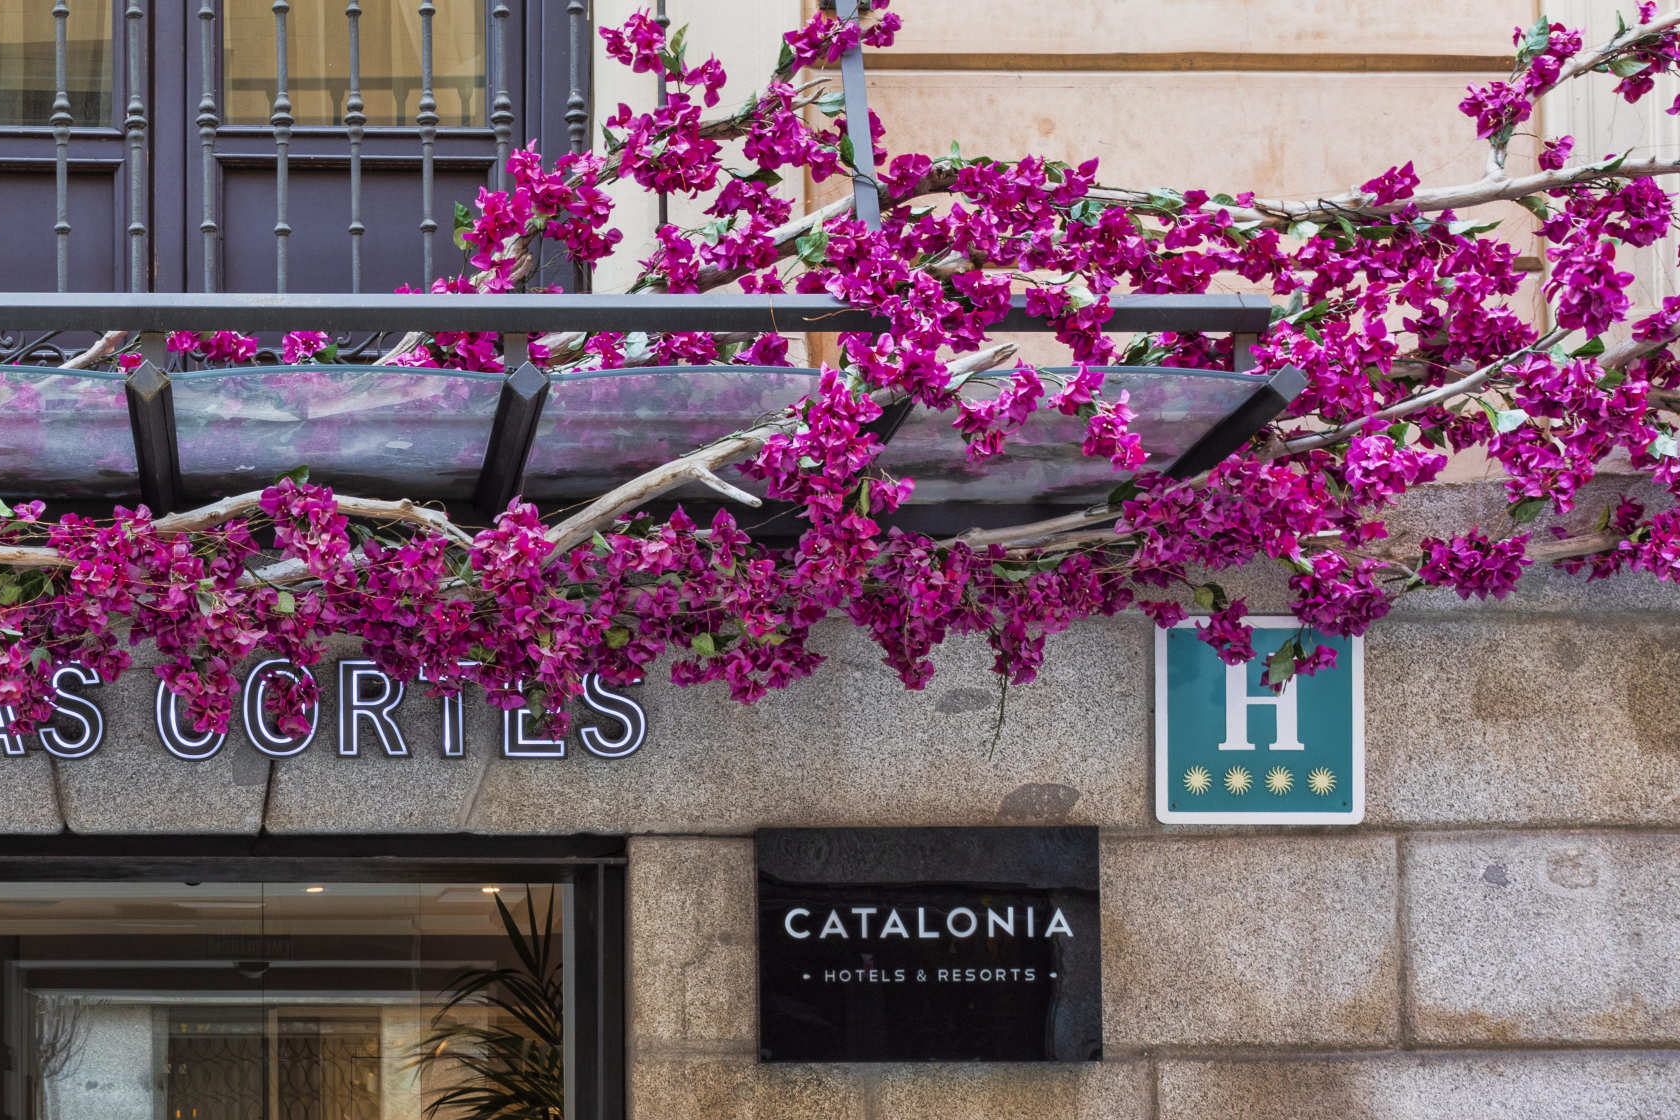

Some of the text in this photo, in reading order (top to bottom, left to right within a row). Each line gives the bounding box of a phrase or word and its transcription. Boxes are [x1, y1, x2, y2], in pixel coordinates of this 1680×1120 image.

[1218, 652, 1305, 750] H
[784, 906, 1074, 939] CATALONIA
[824, 968, 1036, 983] HOTELS & RESORTS
